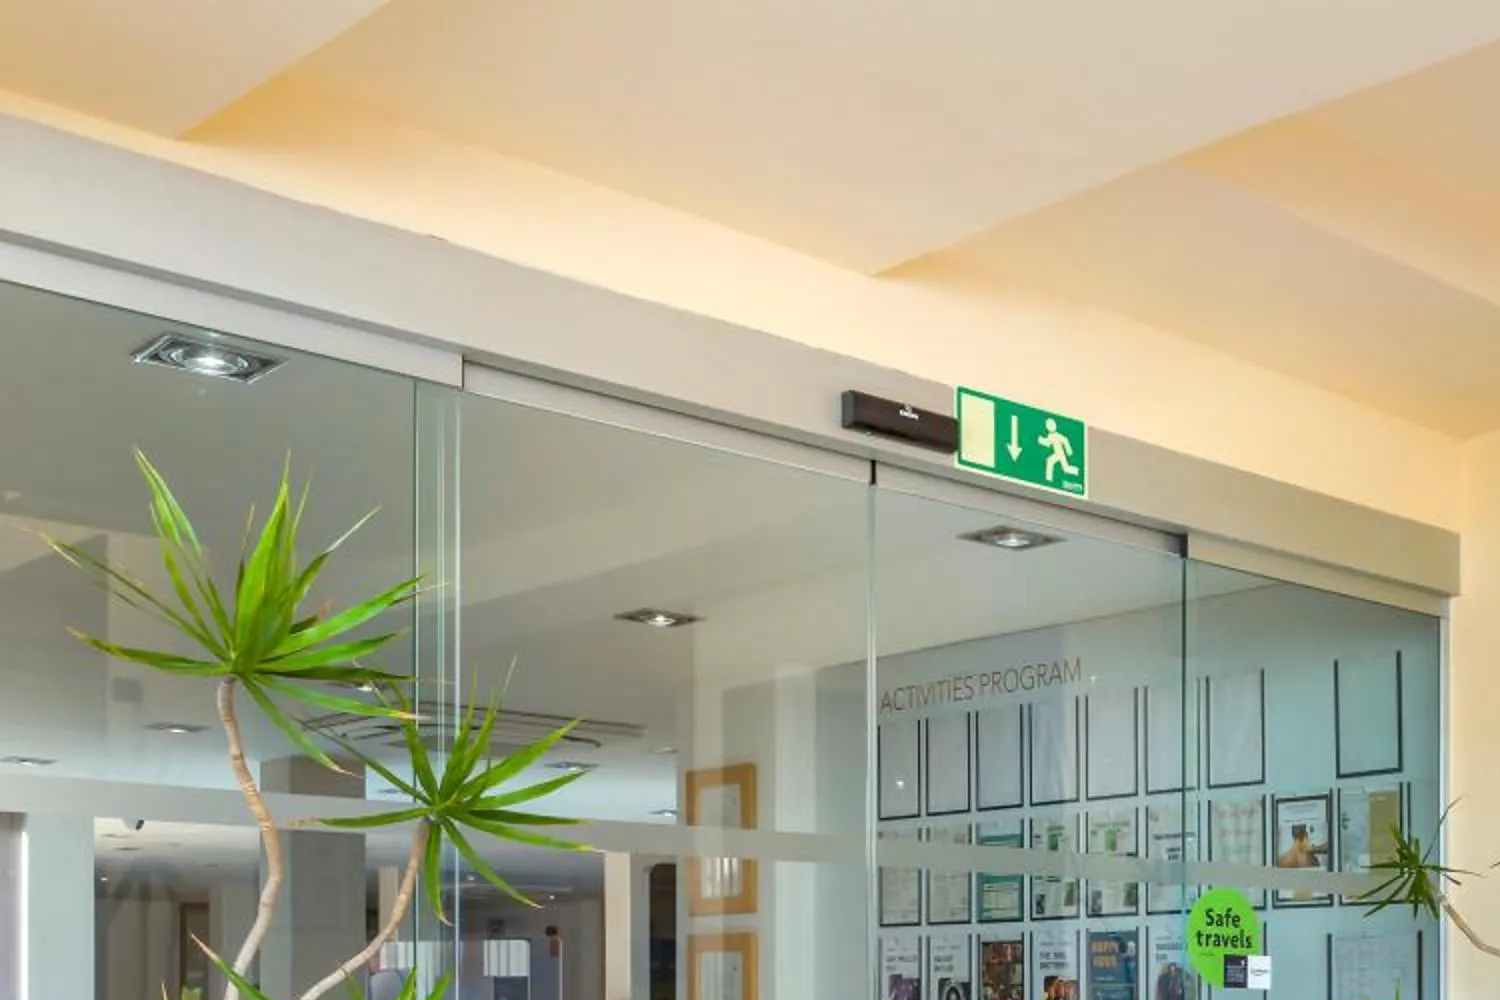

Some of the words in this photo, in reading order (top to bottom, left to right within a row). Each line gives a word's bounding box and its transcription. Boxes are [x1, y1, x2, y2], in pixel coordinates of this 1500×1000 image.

[880, 674, 975, 712] ACTIVITIES
[979, 656, 1081, 694] PROGRAM
[1205, 907, 1241, 928] Safe
[1196, 929, 1252, 949] travels
